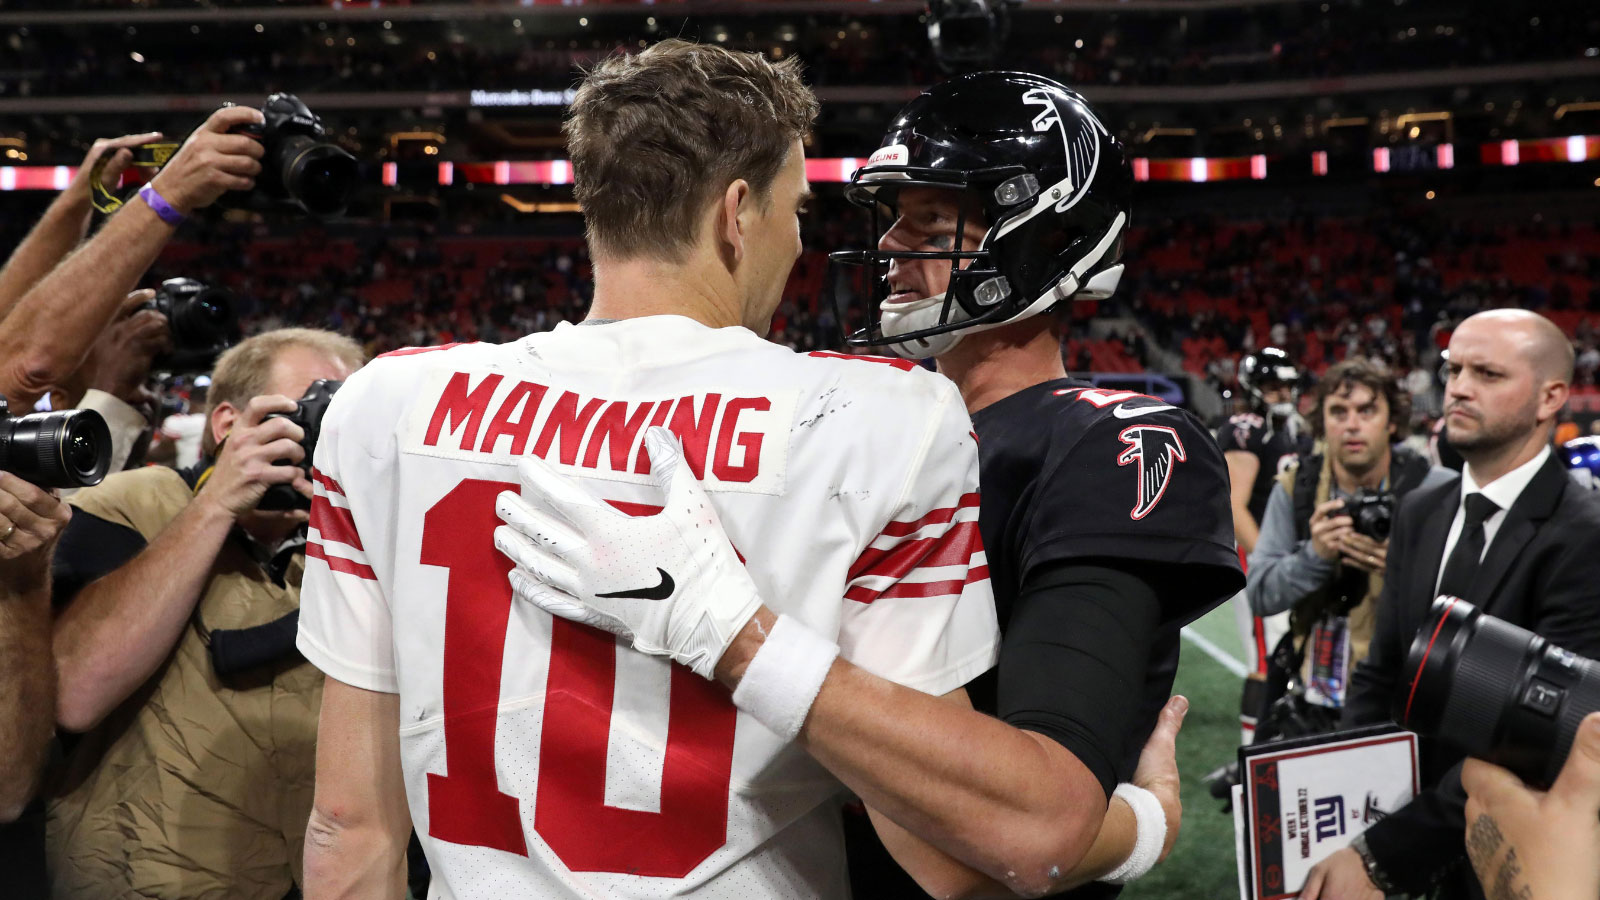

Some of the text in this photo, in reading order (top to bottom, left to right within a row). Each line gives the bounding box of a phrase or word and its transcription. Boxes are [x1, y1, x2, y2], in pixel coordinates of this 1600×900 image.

[423, 371, 772, 483] MANNING
[420, 478, 747, 879] 10
[1287, 819, 1296, 840] WEEK
[1299, 798, 1309, 828] OCTOBER
